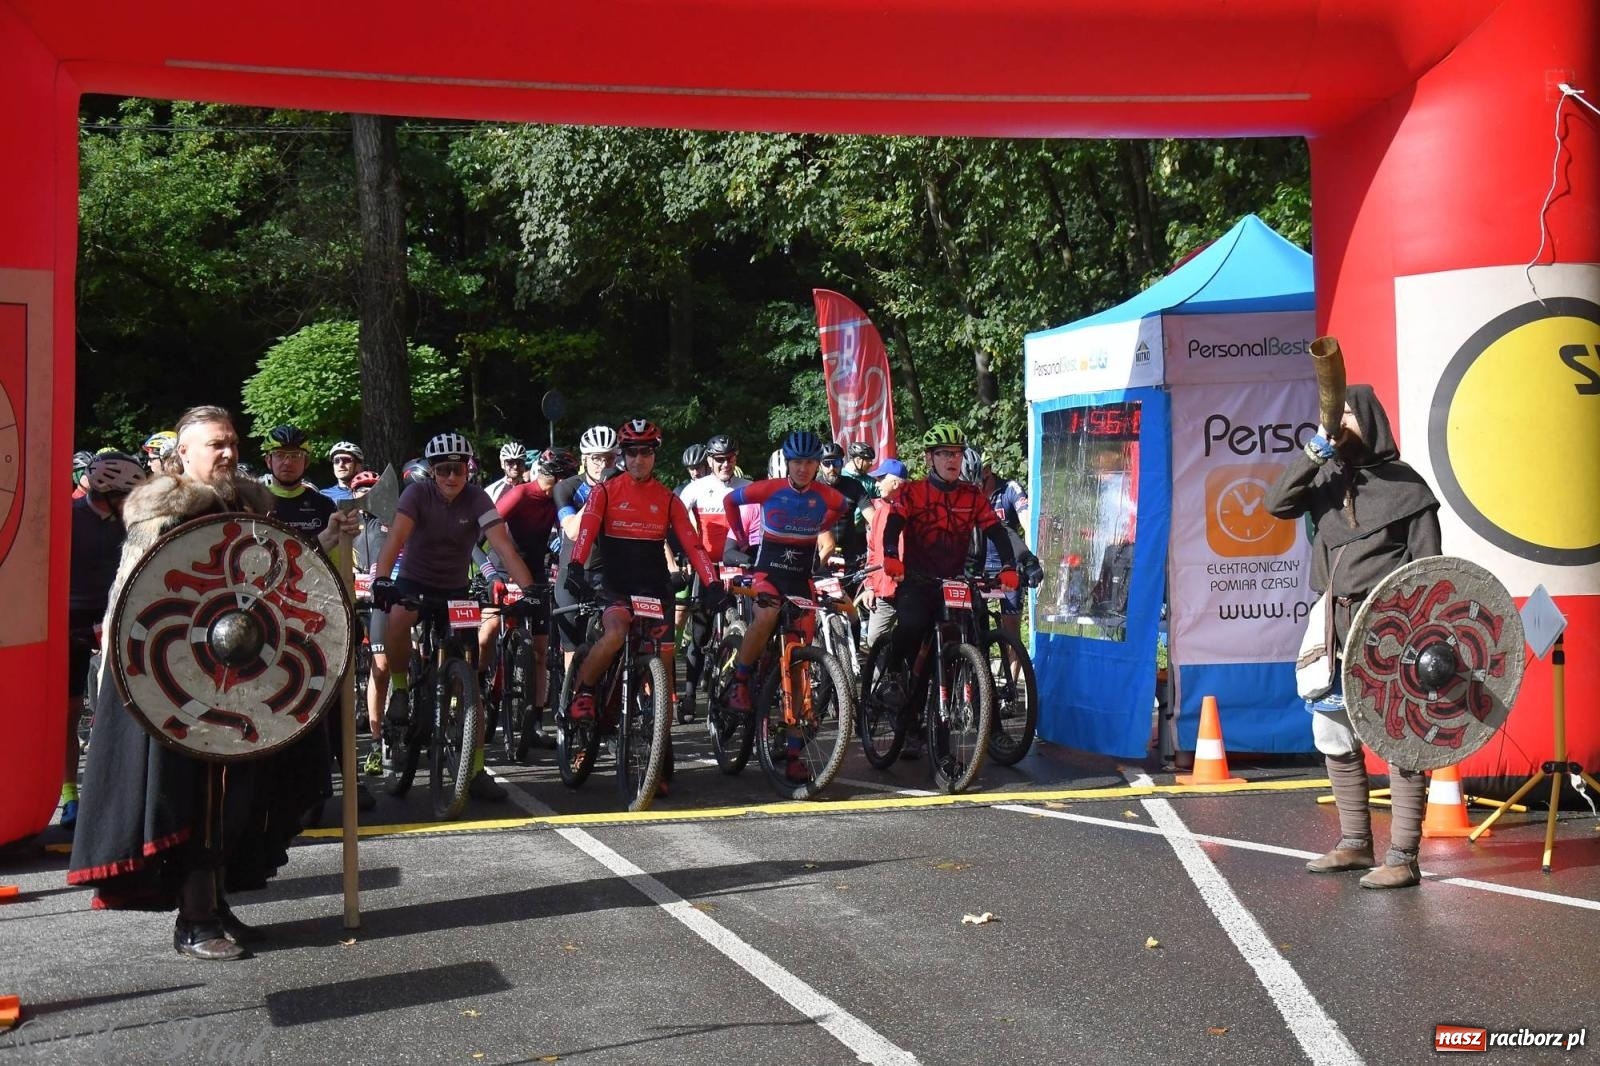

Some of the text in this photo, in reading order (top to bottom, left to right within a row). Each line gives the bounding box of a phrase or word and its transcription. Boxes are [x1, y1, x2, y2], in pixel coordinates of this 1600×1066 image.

[1188, 337, 1310, 359] PersonalBest
[1207, 560, 1300, 575] ELEKTRONICZNY
[1210, 577, 1299, 592] POMIAR CZASU
[947, 589, 966, 599] 132
[635, 602, 660, 612] 100
[455, 609, 474, 619] 141
